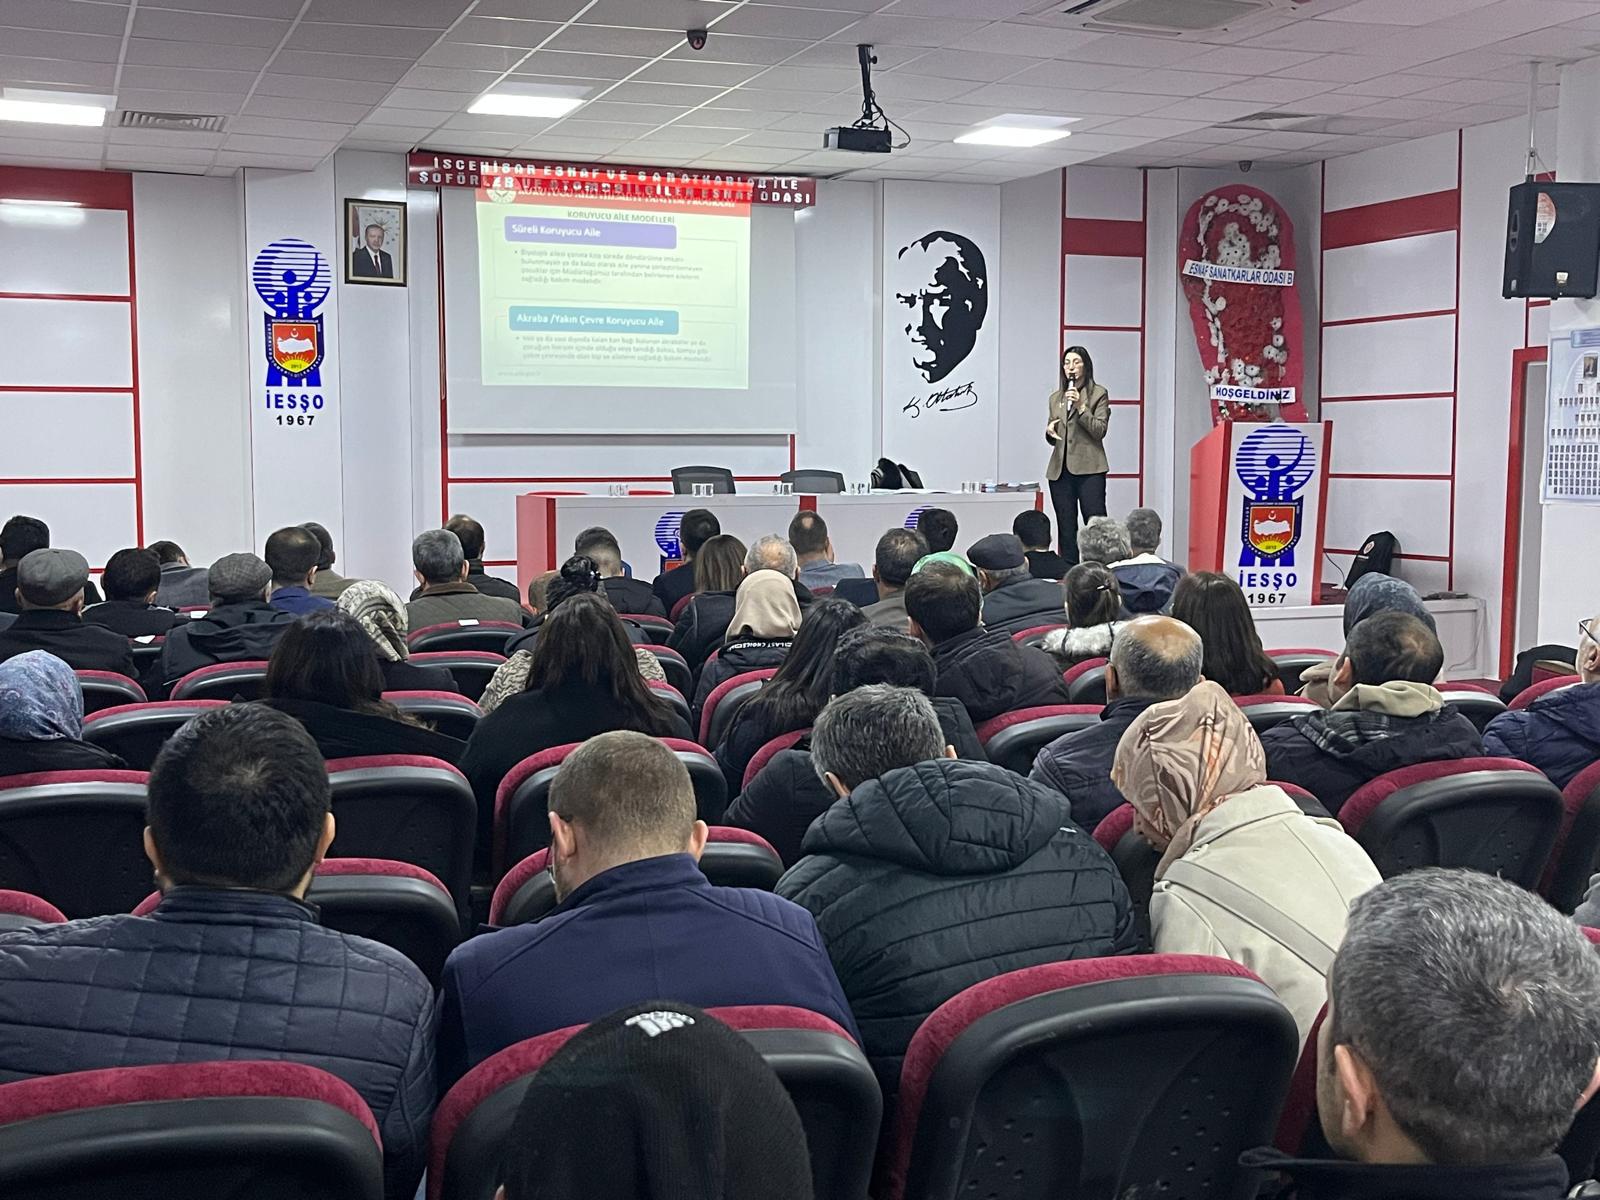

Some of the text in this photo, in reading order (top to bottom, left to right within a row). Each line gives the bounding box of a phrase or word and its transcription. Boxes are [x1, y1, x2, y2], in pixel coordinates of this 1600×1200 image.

[544, 165, 600, 179] ESNAF
[773, 177, 798, 190] İLE
[760, 192, 810, 204] ODASI
[568, 210, 675, 224] KORUYUCU AİLE MODELLERİ
[512, 224, 601, 238] Süreli Koruyucu Aile
[1189, 263, 1208, 275] ESNAF
[1208, 265, 1260, 281] SANATKARLAR
[1262, 271, 1286, 284] ODASI
[516, 314, 548, 324] Akraba
[579, 315, 604, 326] Çevre
[606, 316, 646, 328] Koruyucu
[648, 317, 664, 327] Aile
[266, 390, 324, 413] İESŞO
[276, 415, 315, 425] 1967
[1240, 569, 1297, 591] İESŞO
[1247, 593, 1287, 604] 1967
